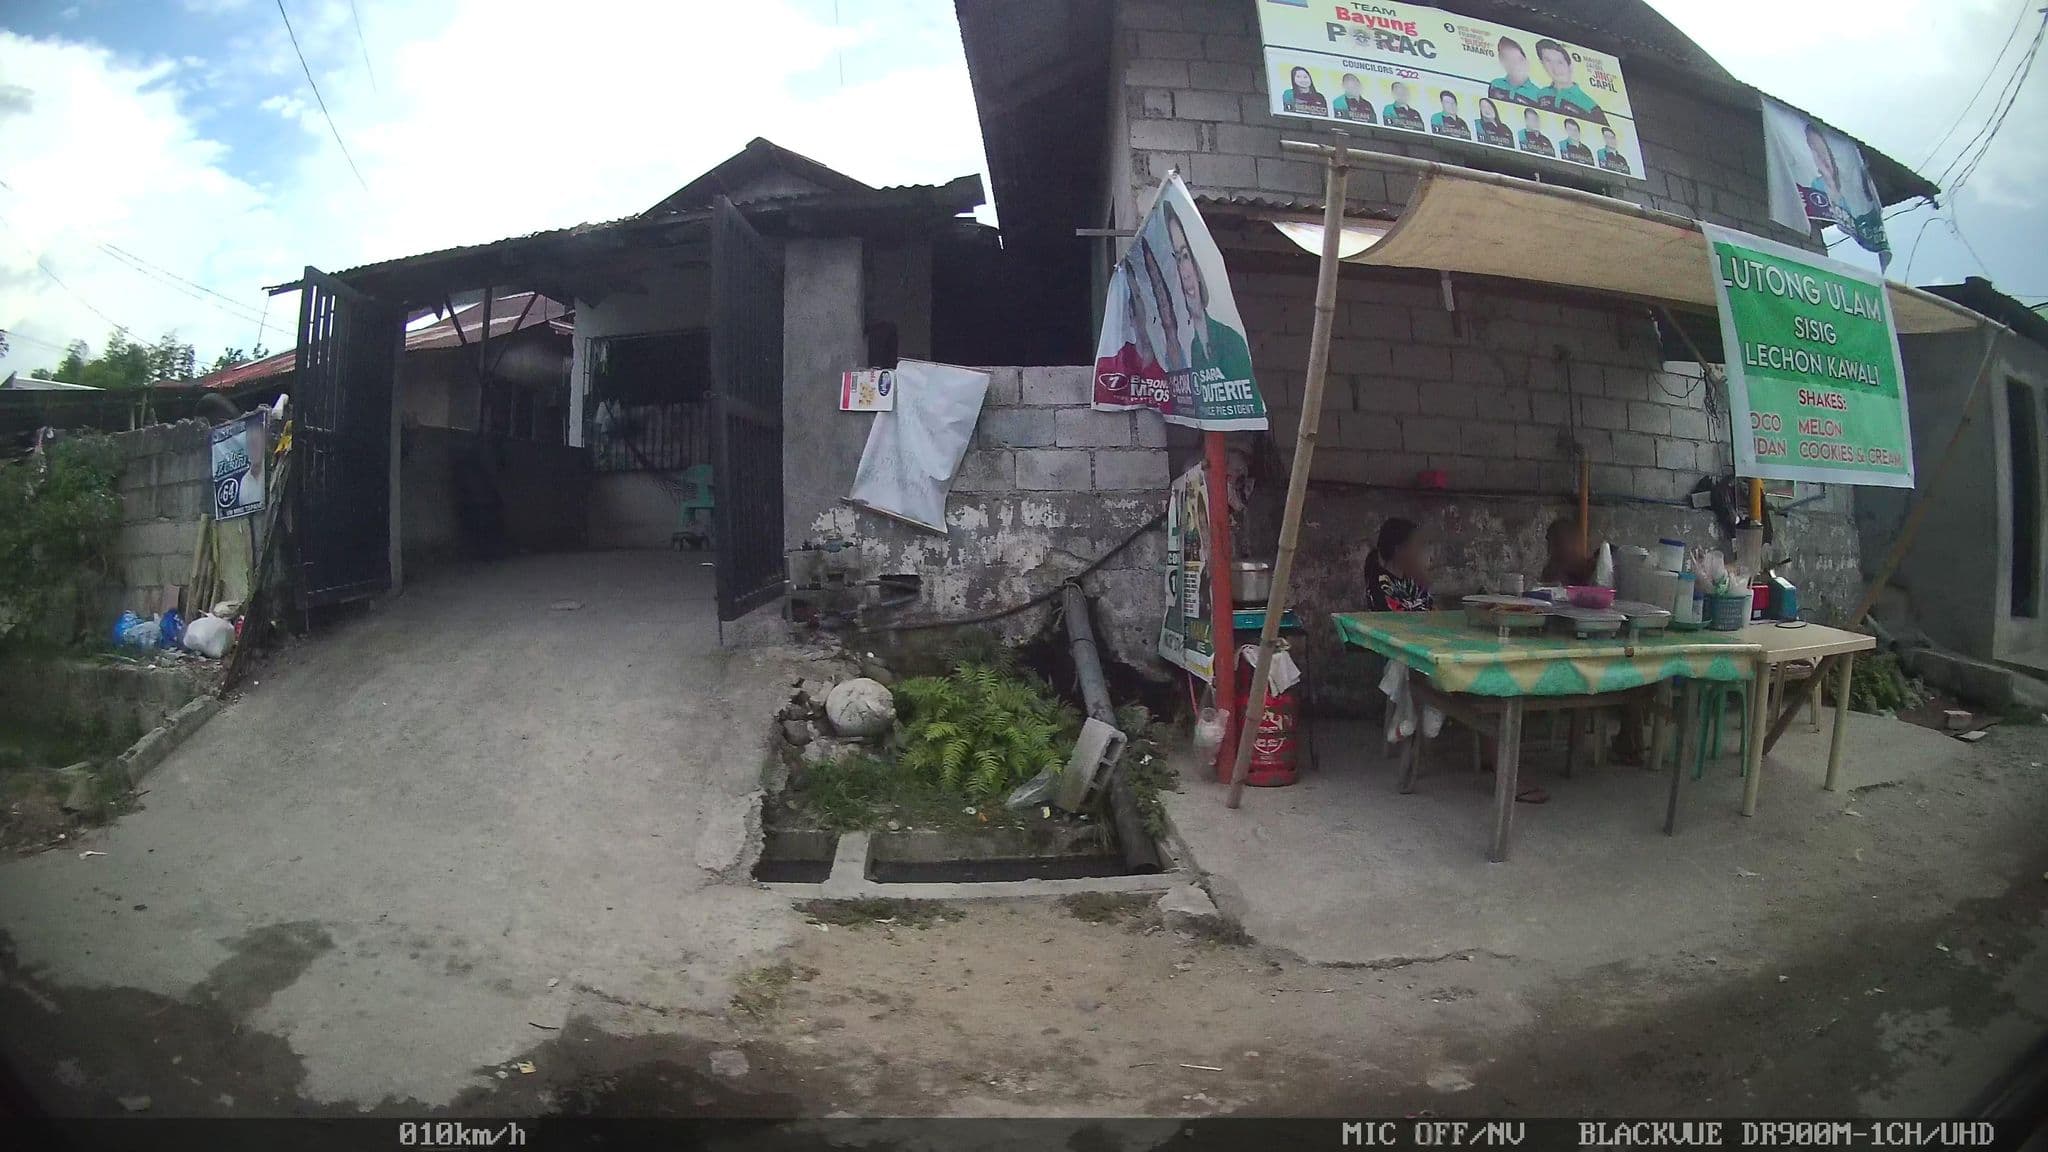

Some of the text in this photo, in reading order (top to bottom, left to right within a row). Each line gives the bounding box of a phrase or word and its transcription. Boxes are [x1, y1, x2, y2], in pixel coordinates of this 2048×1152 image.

[1351, 2, 1396, 16] TEAM
[1335, 6, 1418, 36] Bayung
[1342, 60, 1394, 74] COUNCILORS
[1589, 77, 1618, 93] CAPIL
[1716, 252, 1884, 322] LUTONG ULAM
[1794, 316, 1837, 345] SISIG
[1745, 343, 1879, 386] LECHON KAWALI
[1799, 389, 1847, 410] SHAKES:
[1799, 419, 1842, 437] MELON
[1753, 438, 1787, 456] DAN
[1800, 442, 1854, 463] COOKIES
